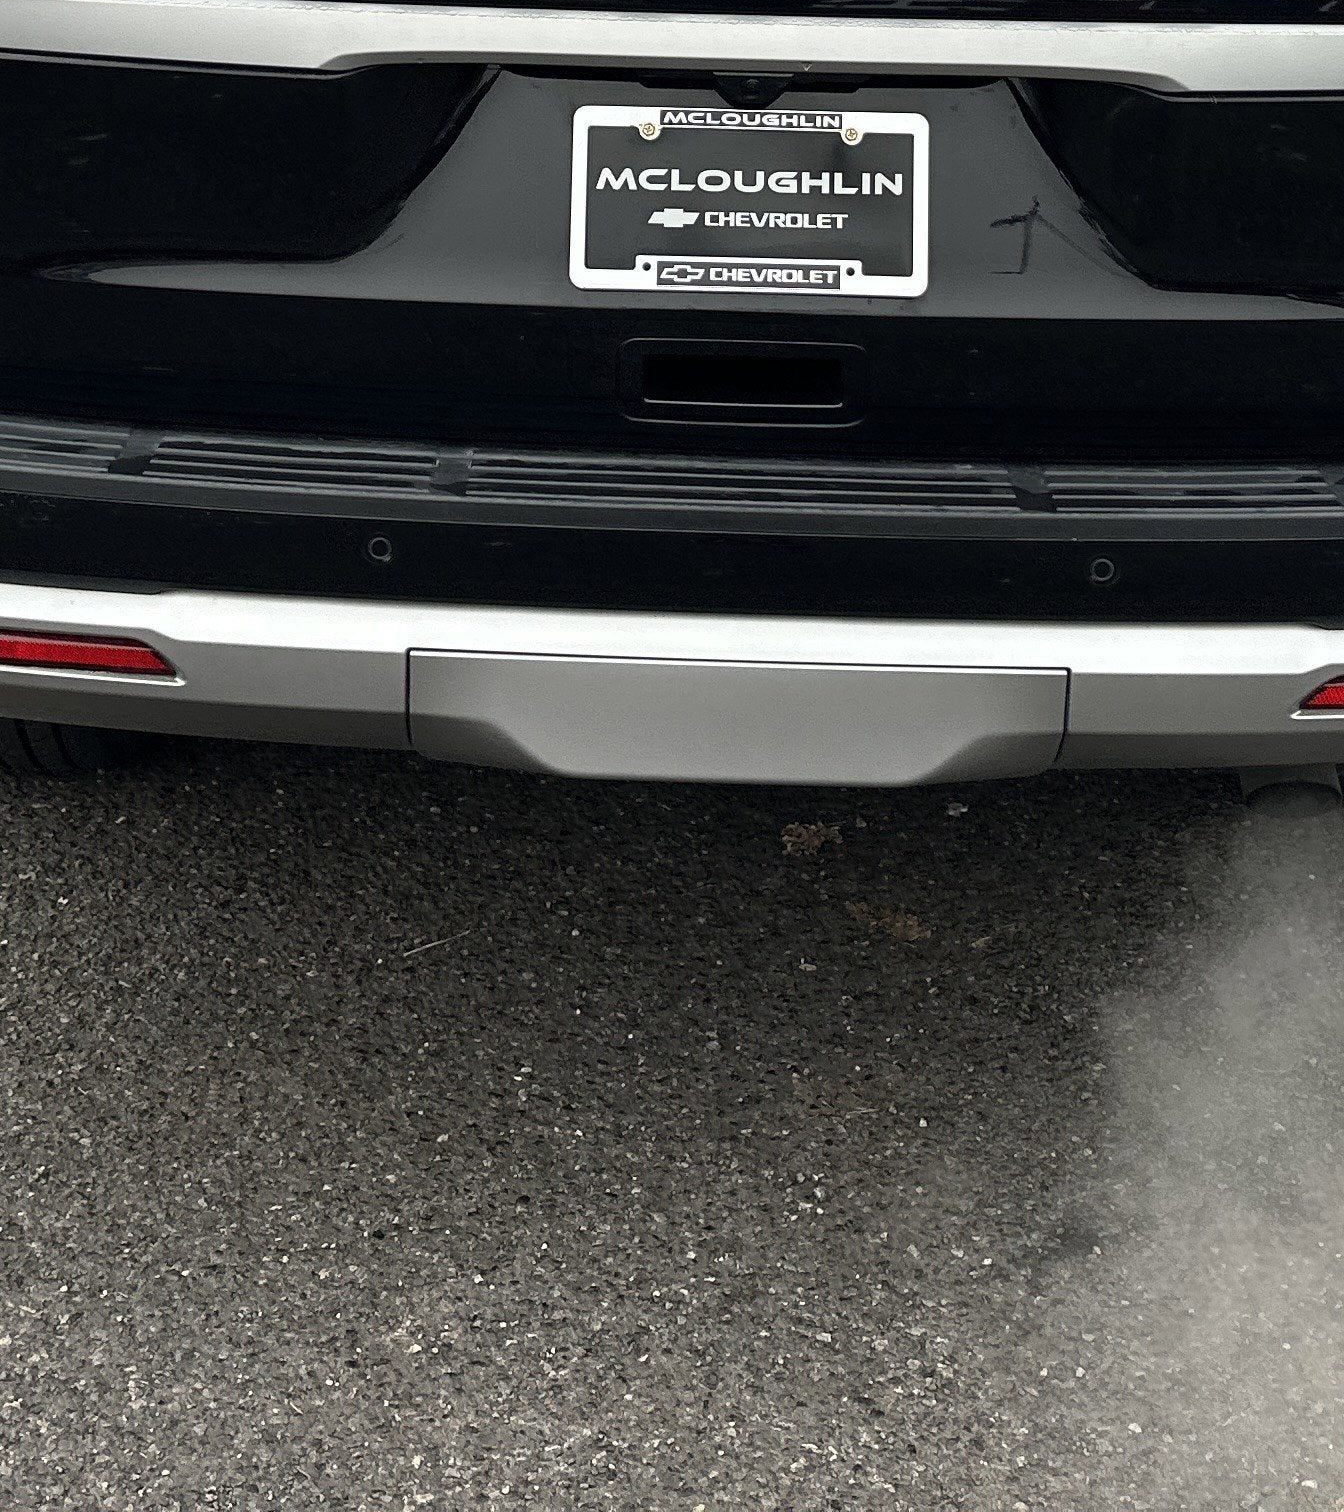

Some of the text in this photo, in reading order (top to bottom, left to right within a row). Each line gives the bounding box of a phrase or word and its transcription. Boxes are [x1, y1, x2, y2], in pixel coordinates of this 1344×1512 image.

[661, 110, 842, 129] MCLOUGHLIN
[595, 166, 904, 196] MCLOUGHLIN
[703, 211, 849, 230] CHEVROLET
[708, 266, 838, 284] CHEVROLET
